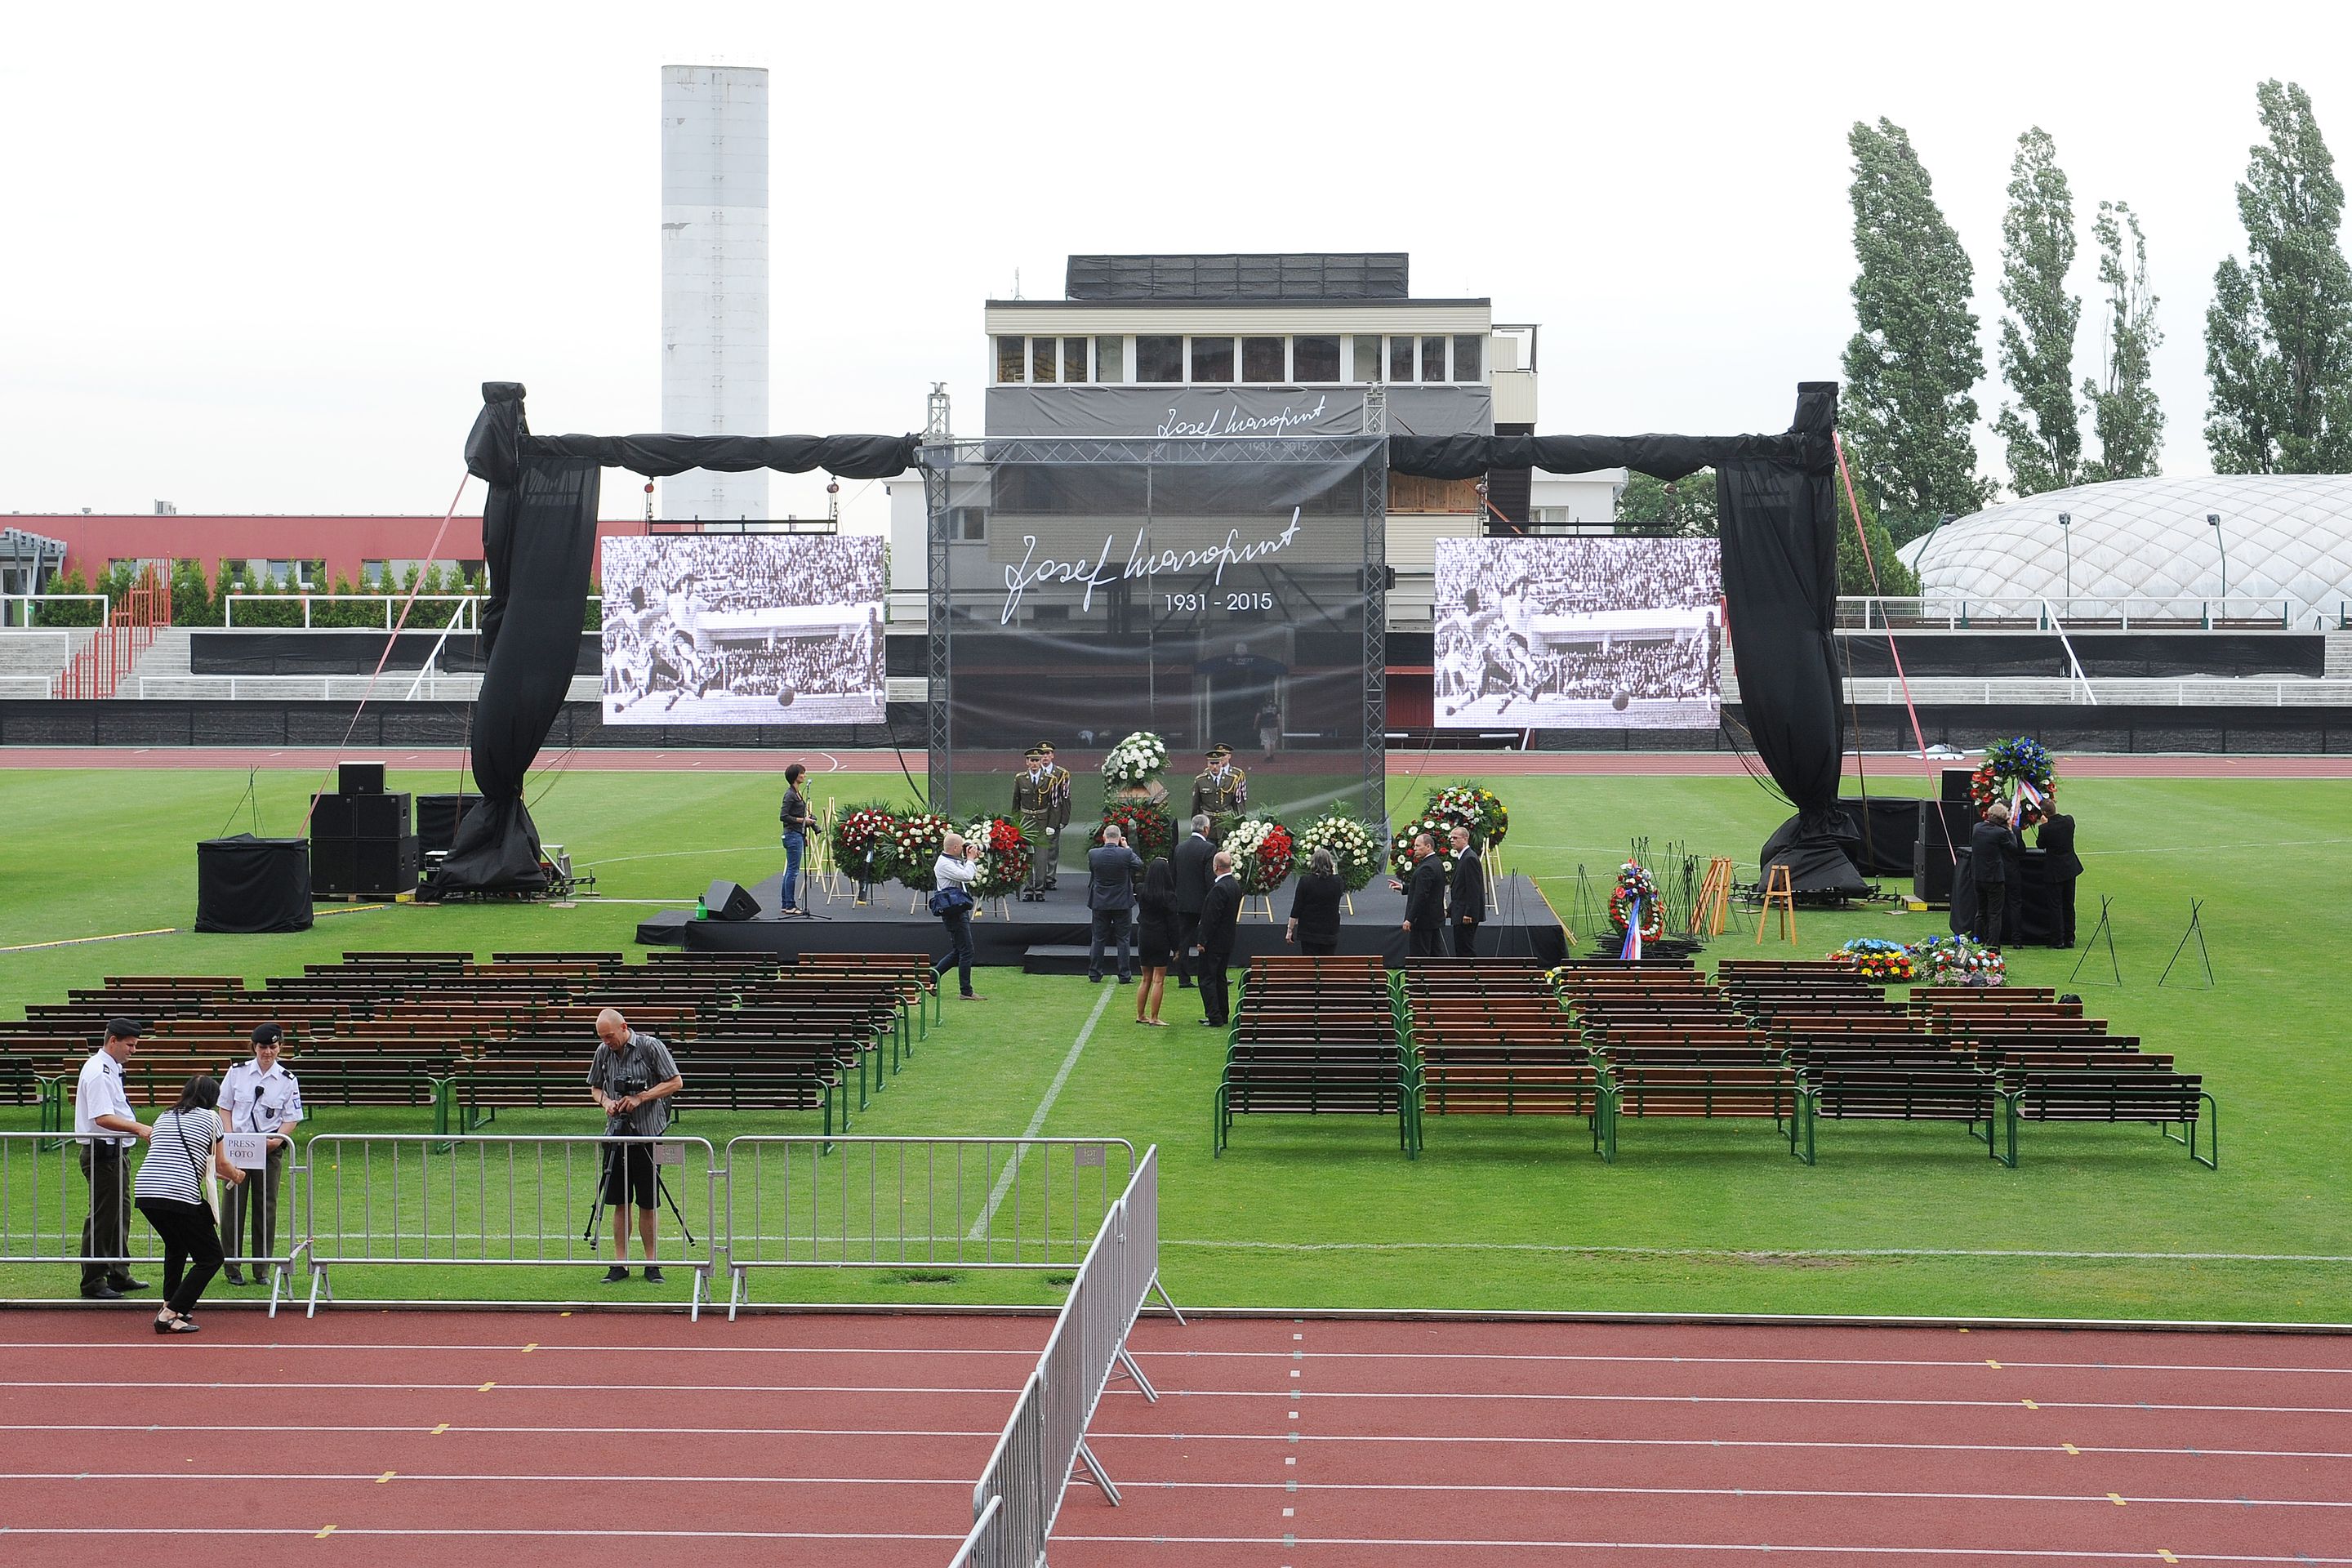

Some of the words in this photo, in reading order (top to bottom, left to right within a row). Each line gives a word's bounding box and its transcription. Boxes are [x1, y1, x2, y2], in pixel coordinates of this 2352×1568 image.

[1000, 534, 1118, 625] Josef
[1165, 594, 1206, 611] 1931
[1226, 593, 1272, 611] 2015
[228, 1139, 256, 1148] PRESS
[229, 1150, 254, 1158] FOTO
